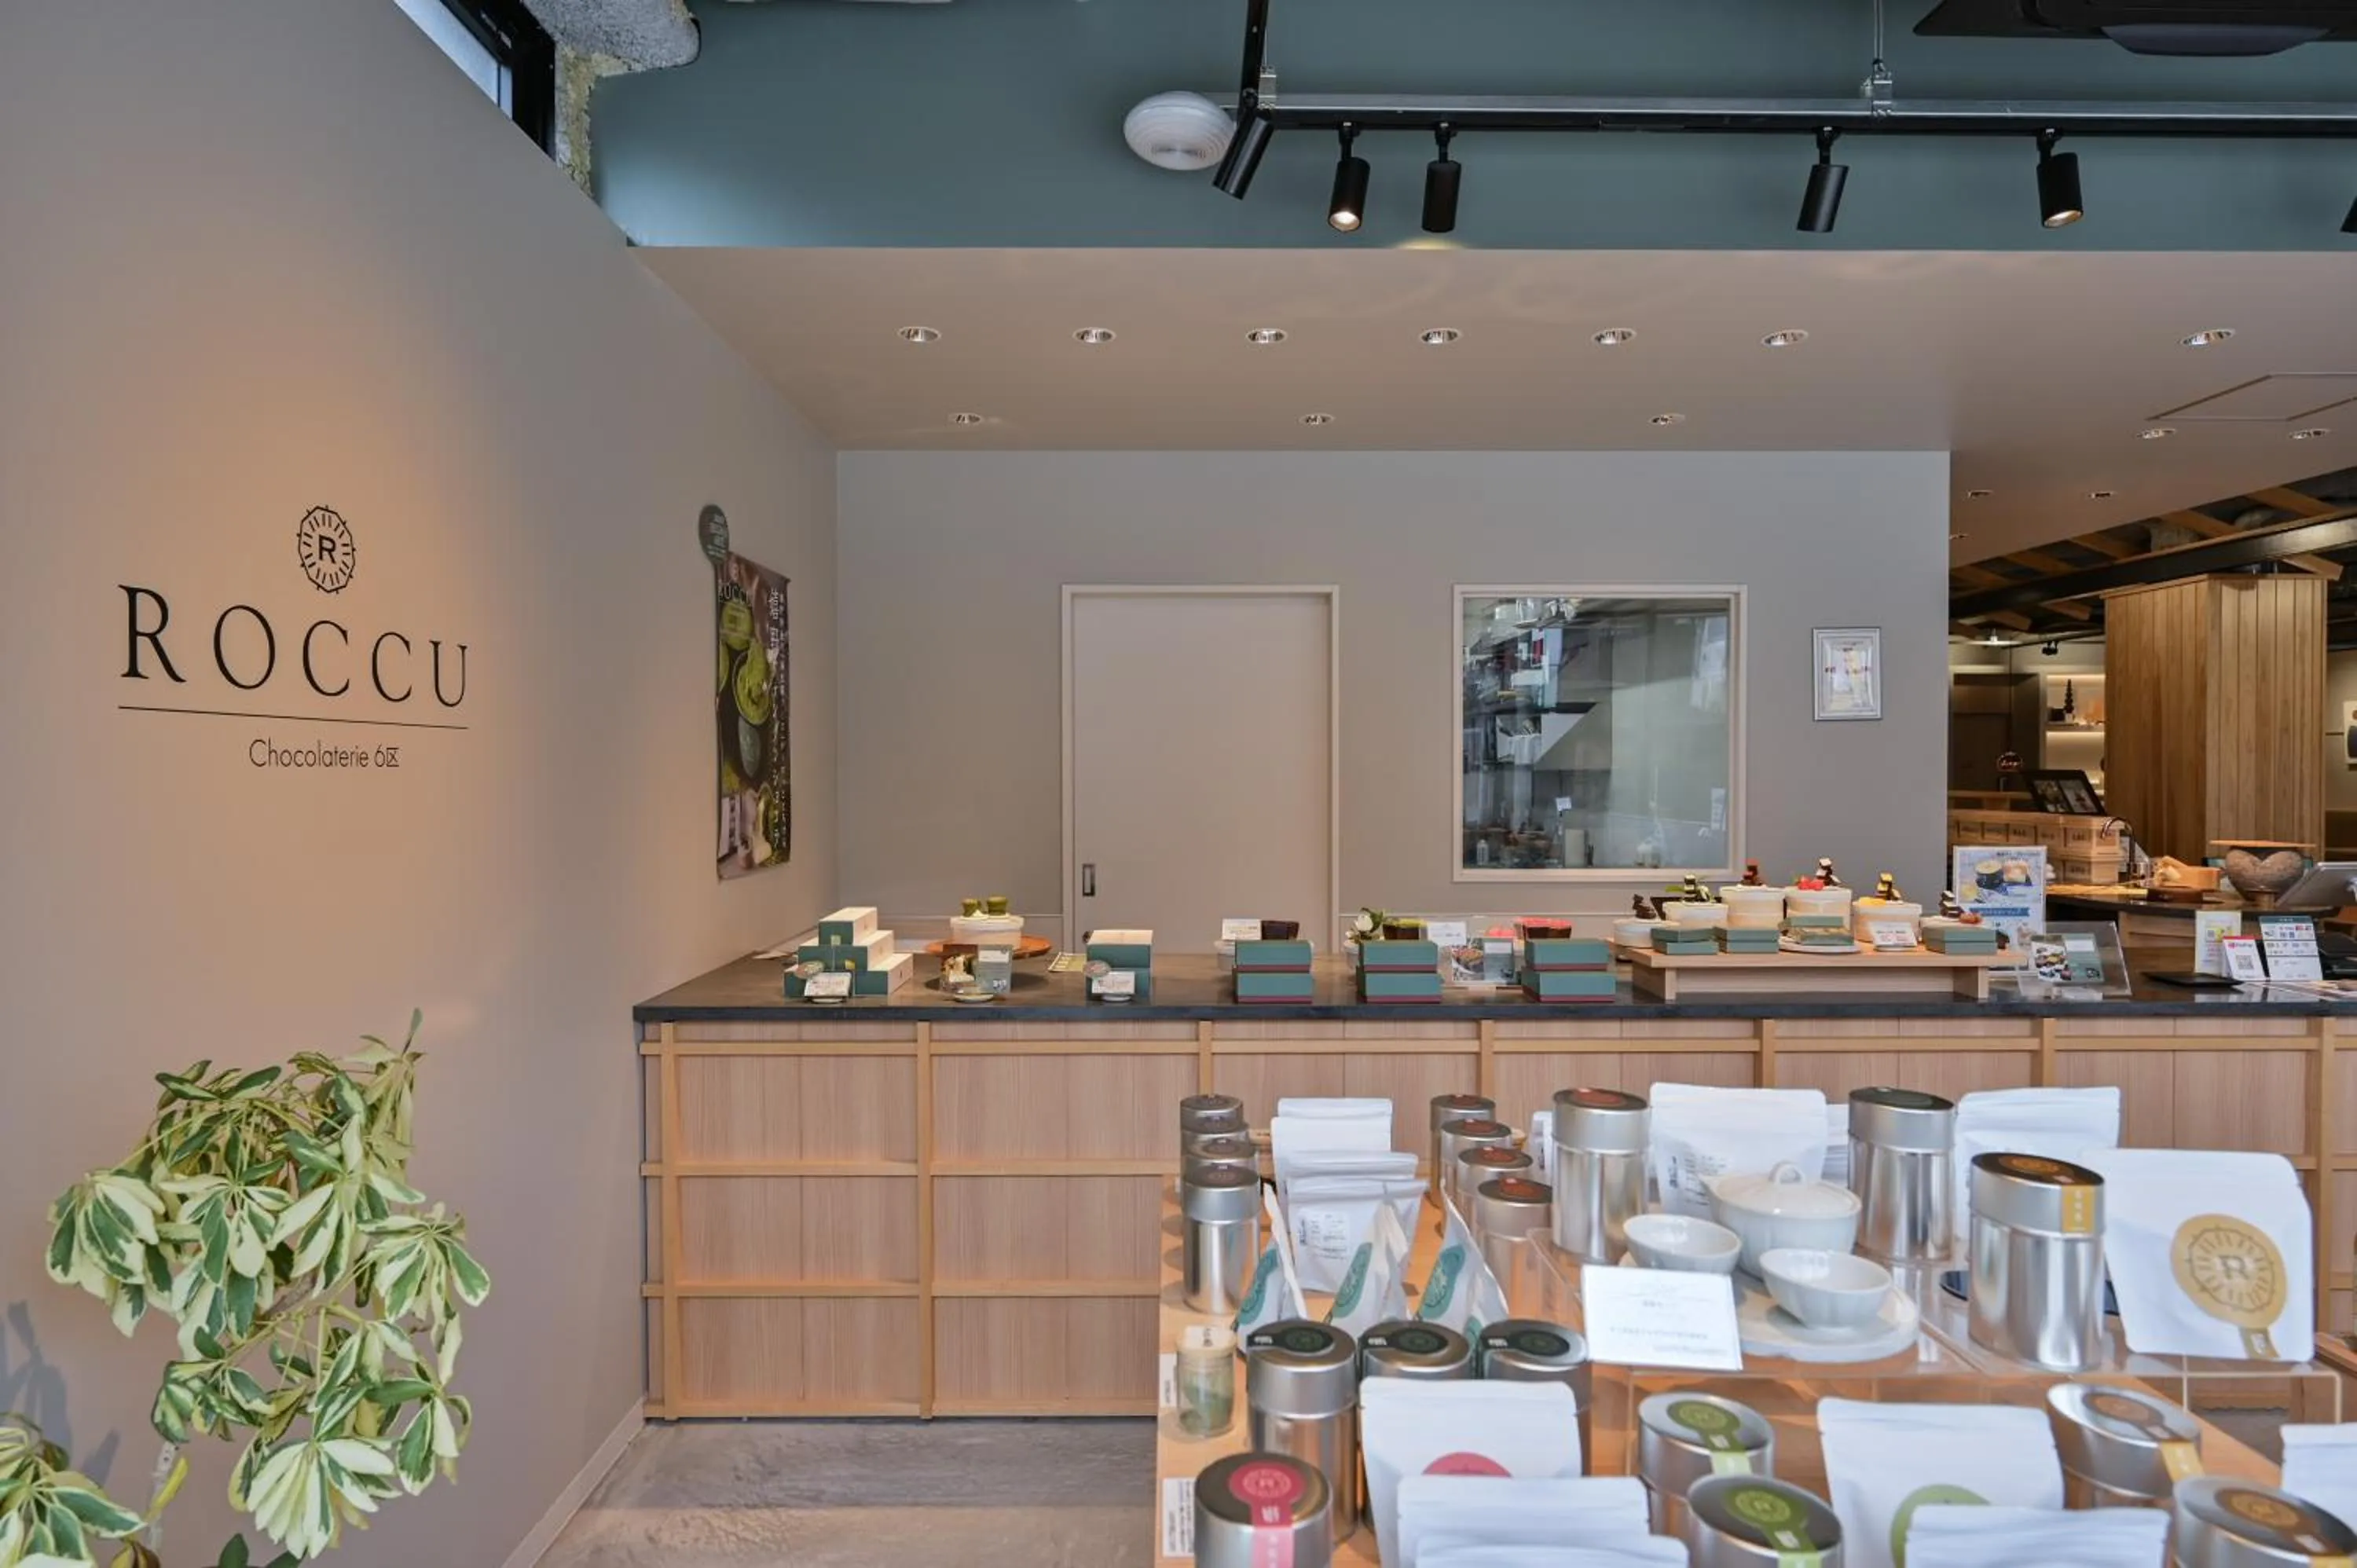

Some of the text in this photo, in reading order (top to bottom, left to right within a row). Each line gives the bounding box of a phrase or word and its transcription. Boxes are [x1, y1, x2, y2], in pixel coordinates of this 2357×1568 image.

[318, 534, 336, 564] R
[117, 584, 468, 707] ROCCU
[249, 736, 369, 768] Chocolaterie
[2217, 1255, 2249, 1280] R
